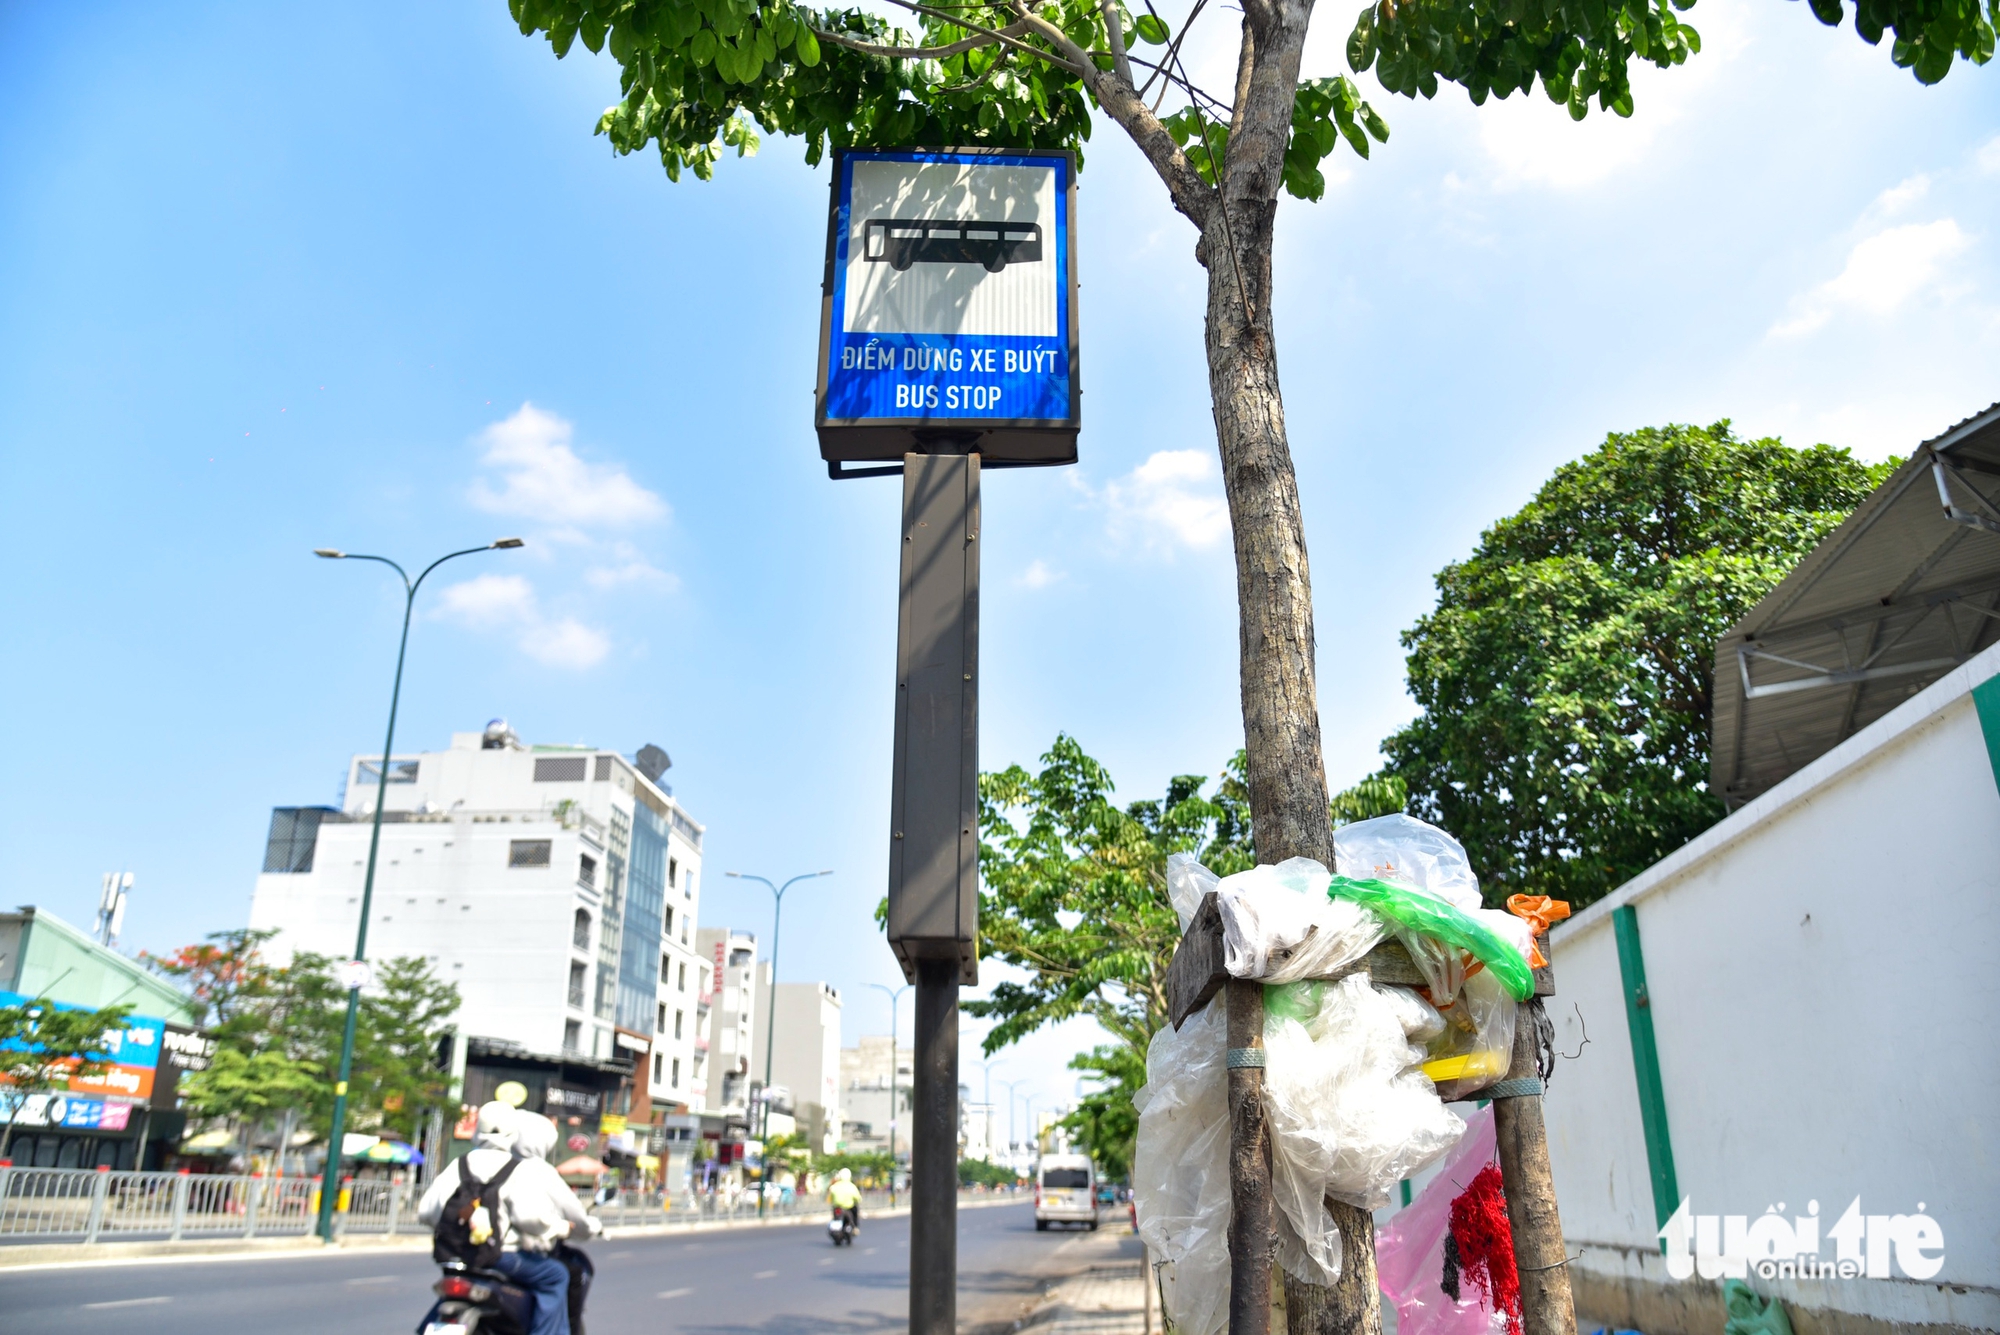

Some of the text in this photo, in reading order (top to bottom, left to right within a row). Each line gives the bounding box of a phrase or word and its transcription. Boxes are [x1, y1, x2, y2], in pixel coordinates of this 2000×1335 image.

[841, 338, 1059, 374] ĐIỂM DỪNG XE BUÝT
[896, 384, 1002, 410] BUS STOP
